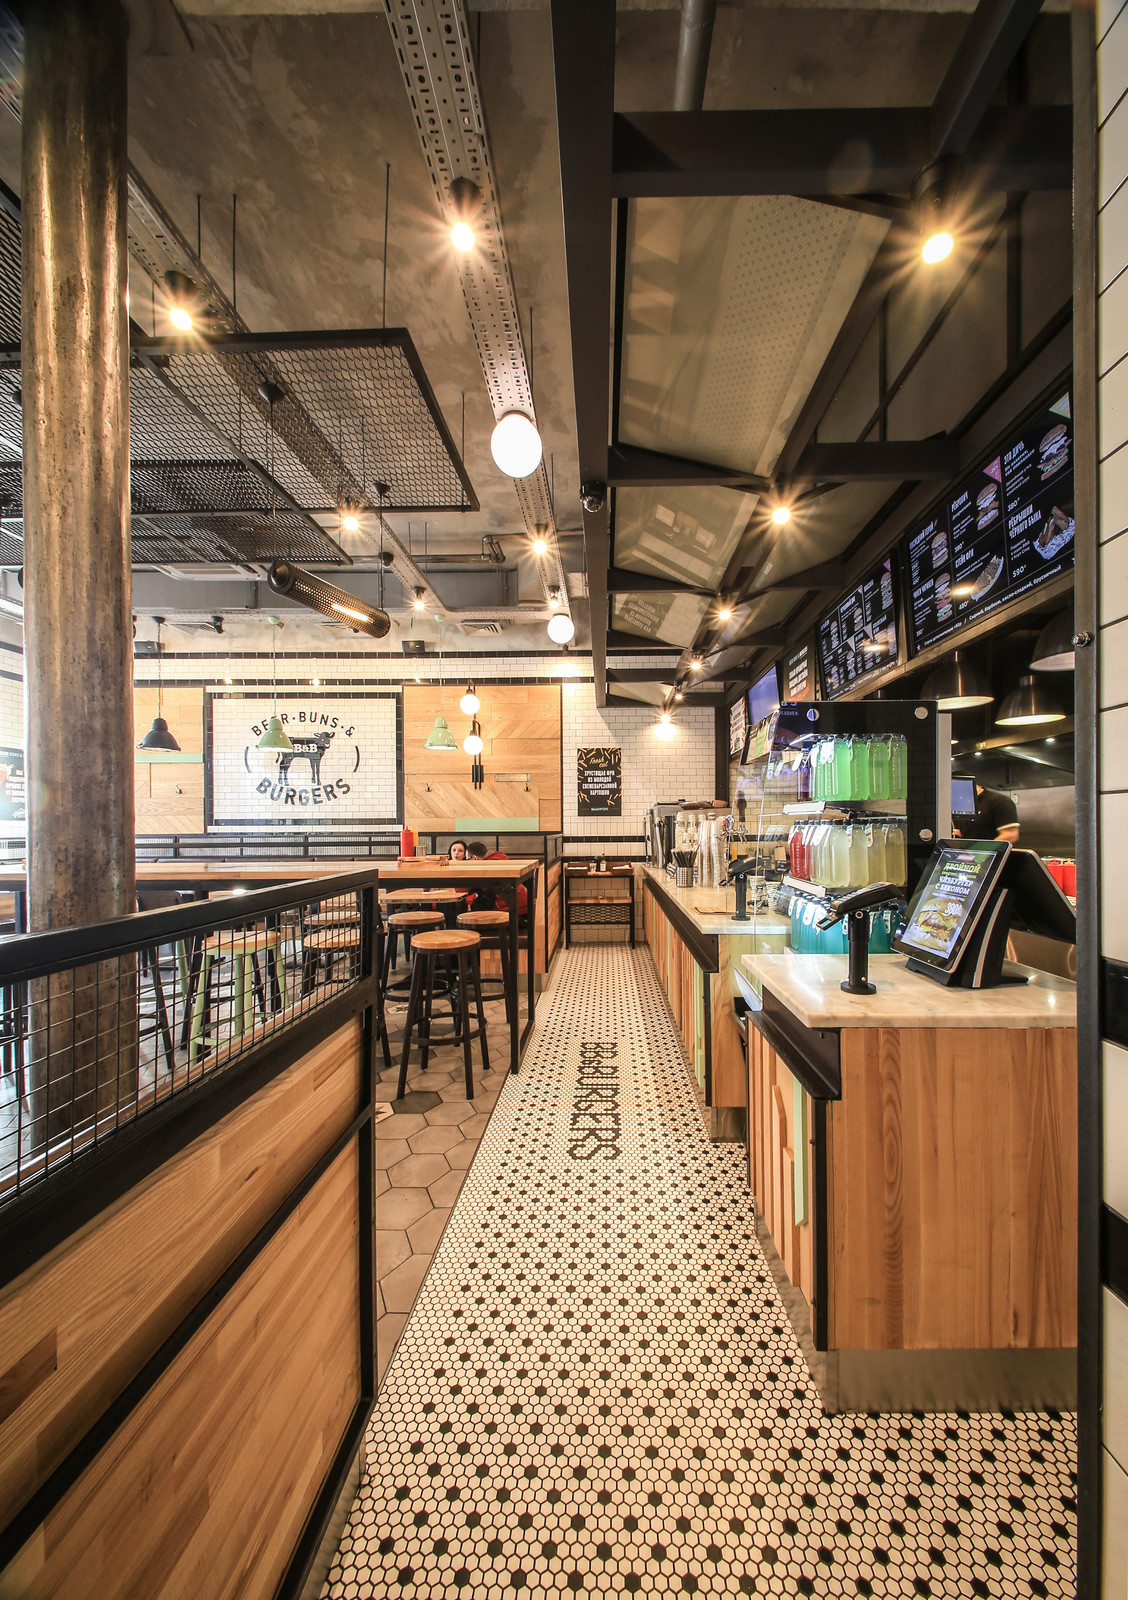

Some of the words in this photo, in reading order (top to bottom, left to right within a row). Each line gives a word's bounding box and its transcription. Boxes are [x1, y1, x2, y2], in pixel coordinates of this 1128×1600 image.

[1008, 503, 1034, 530] РЁБРЫШКИ
[251, 713, 289, 737] BER
[294, 743, 318, 753] B&B
[255, 776, 351, 806] BURGERS
[942, 862, 981, 874] ДВОЙНОЙ
[940, 884, 970, 895] БЕКОНОМ
